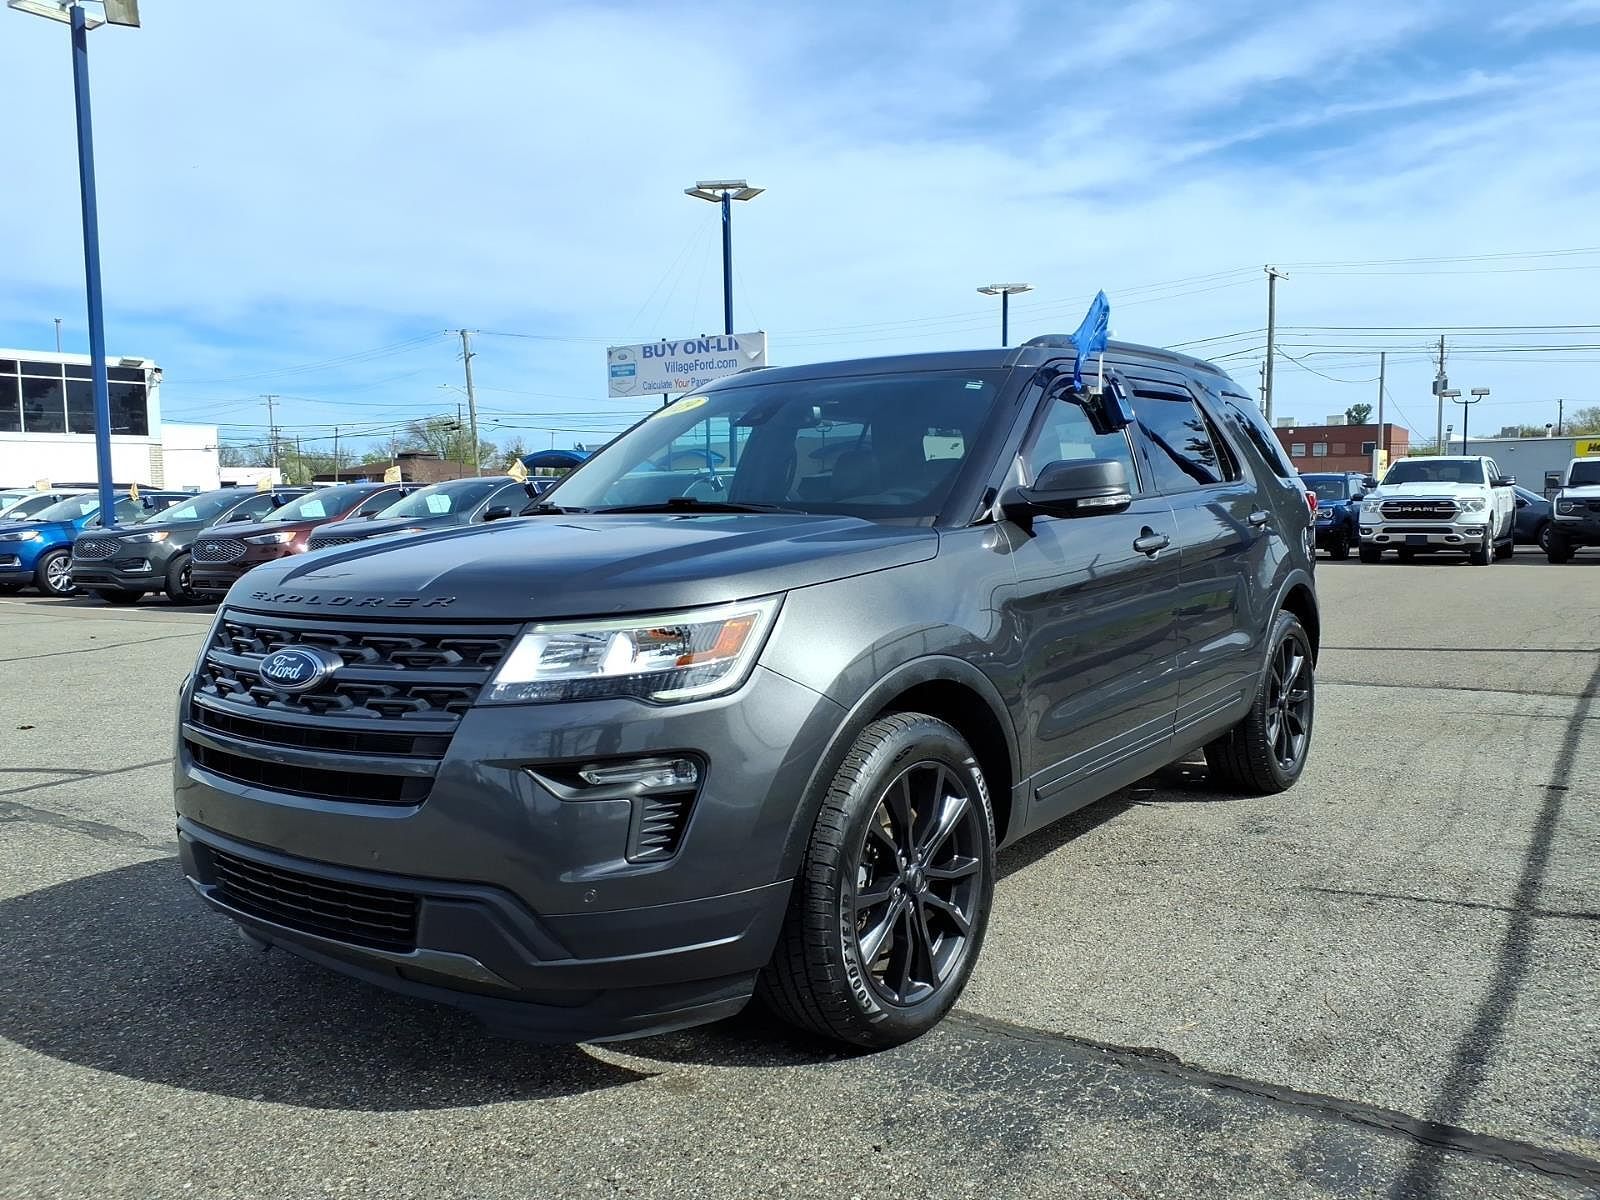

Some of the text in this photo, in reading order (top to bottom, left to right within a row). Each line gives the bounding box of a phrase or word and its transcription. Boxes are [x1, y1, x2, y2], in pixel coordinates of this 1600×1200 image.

[642, 343, 678, 359] BUY
[664, 358, 738, 374] VillageFord.com
[642, 380, 673, 391] Calculate
[674, 377, 690, 389] Your
[251, 591, 457, 607] EXPLORER
[267, 655, 303, 680] Ford
